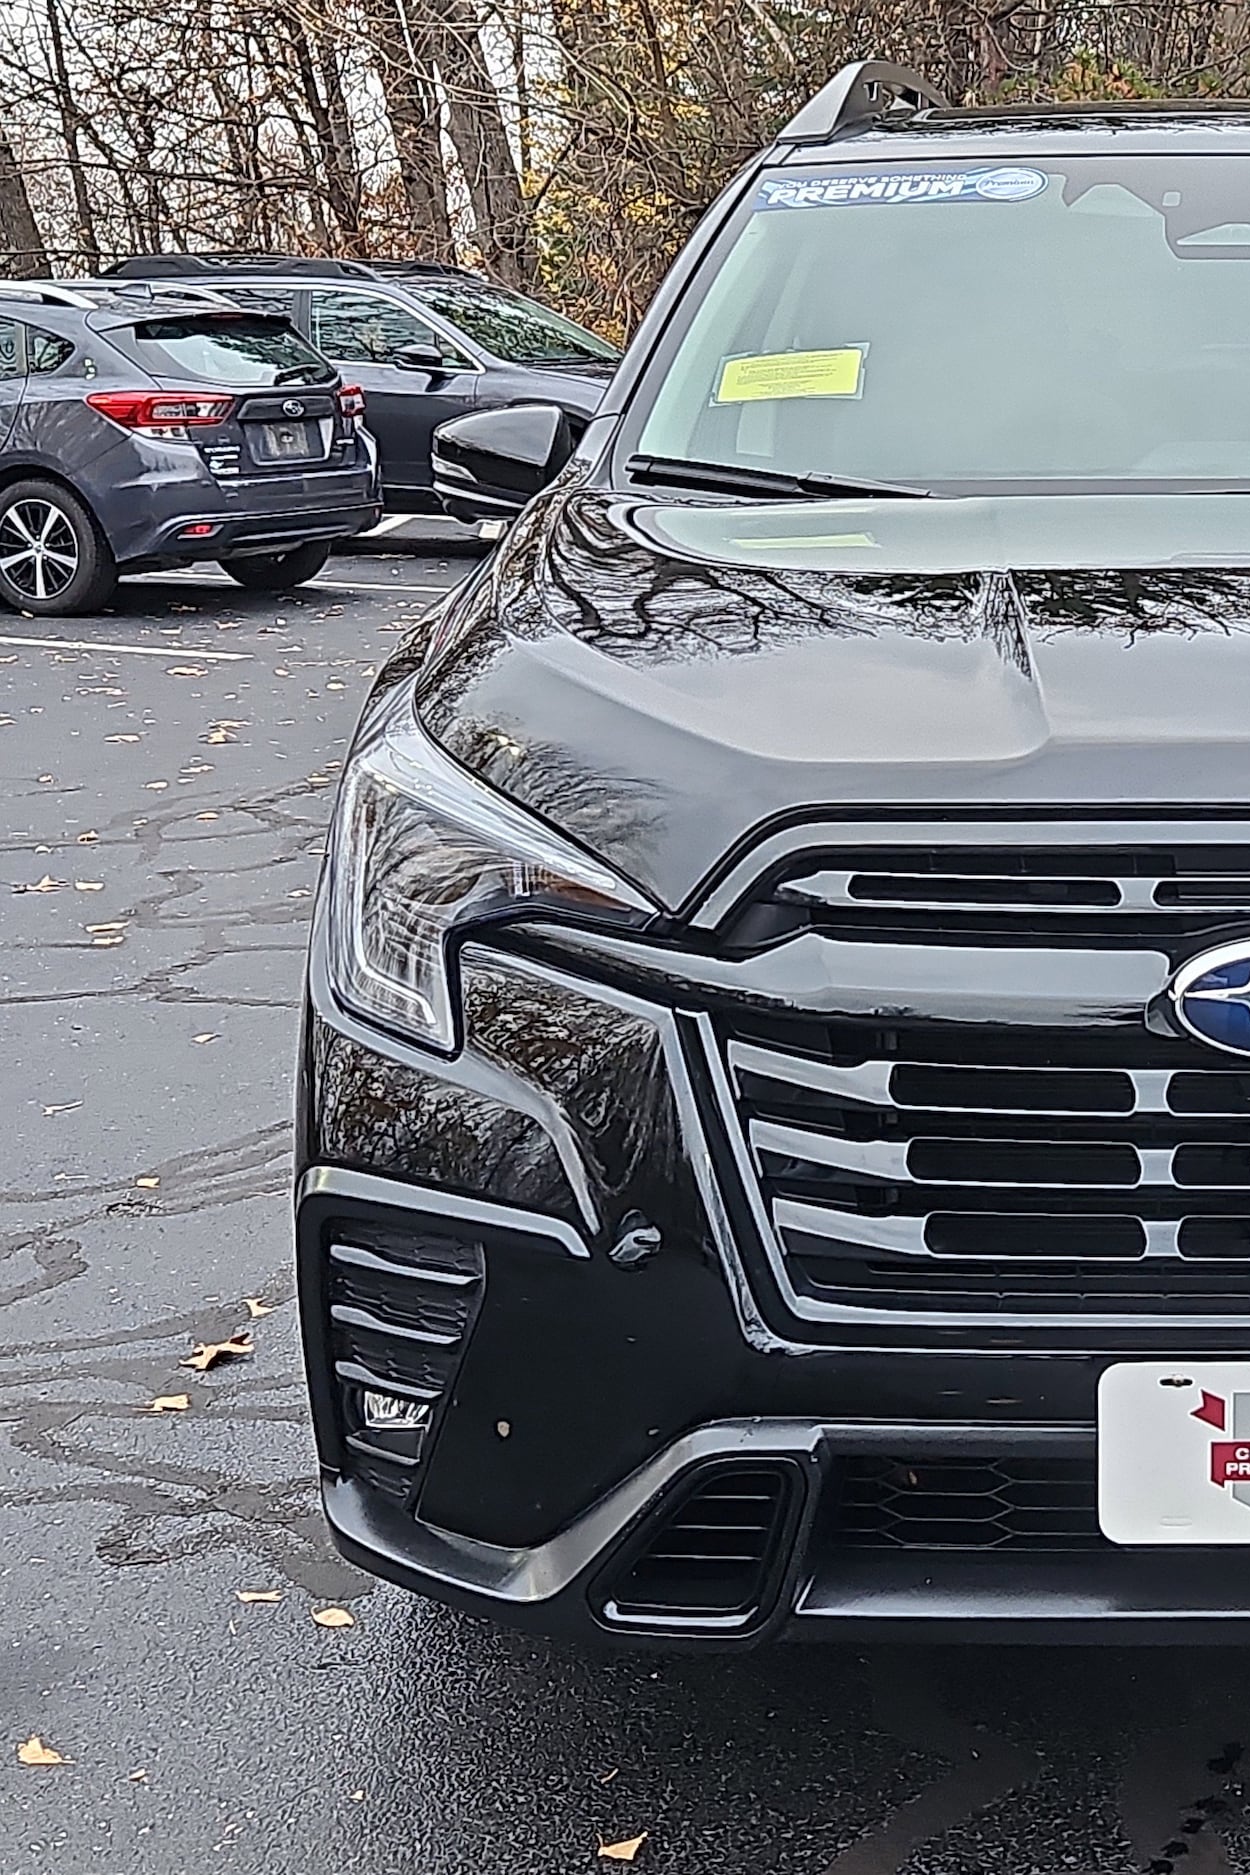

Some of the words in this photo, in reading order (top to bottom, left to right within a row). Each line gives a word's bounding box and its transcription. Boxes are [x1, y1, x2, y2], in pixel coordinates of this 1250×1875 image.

[810, 176, 878, 187] DESERVE
[880, 173, 968, 182] SOMETHING
[767, 180, 965, 205] PREMIUM
